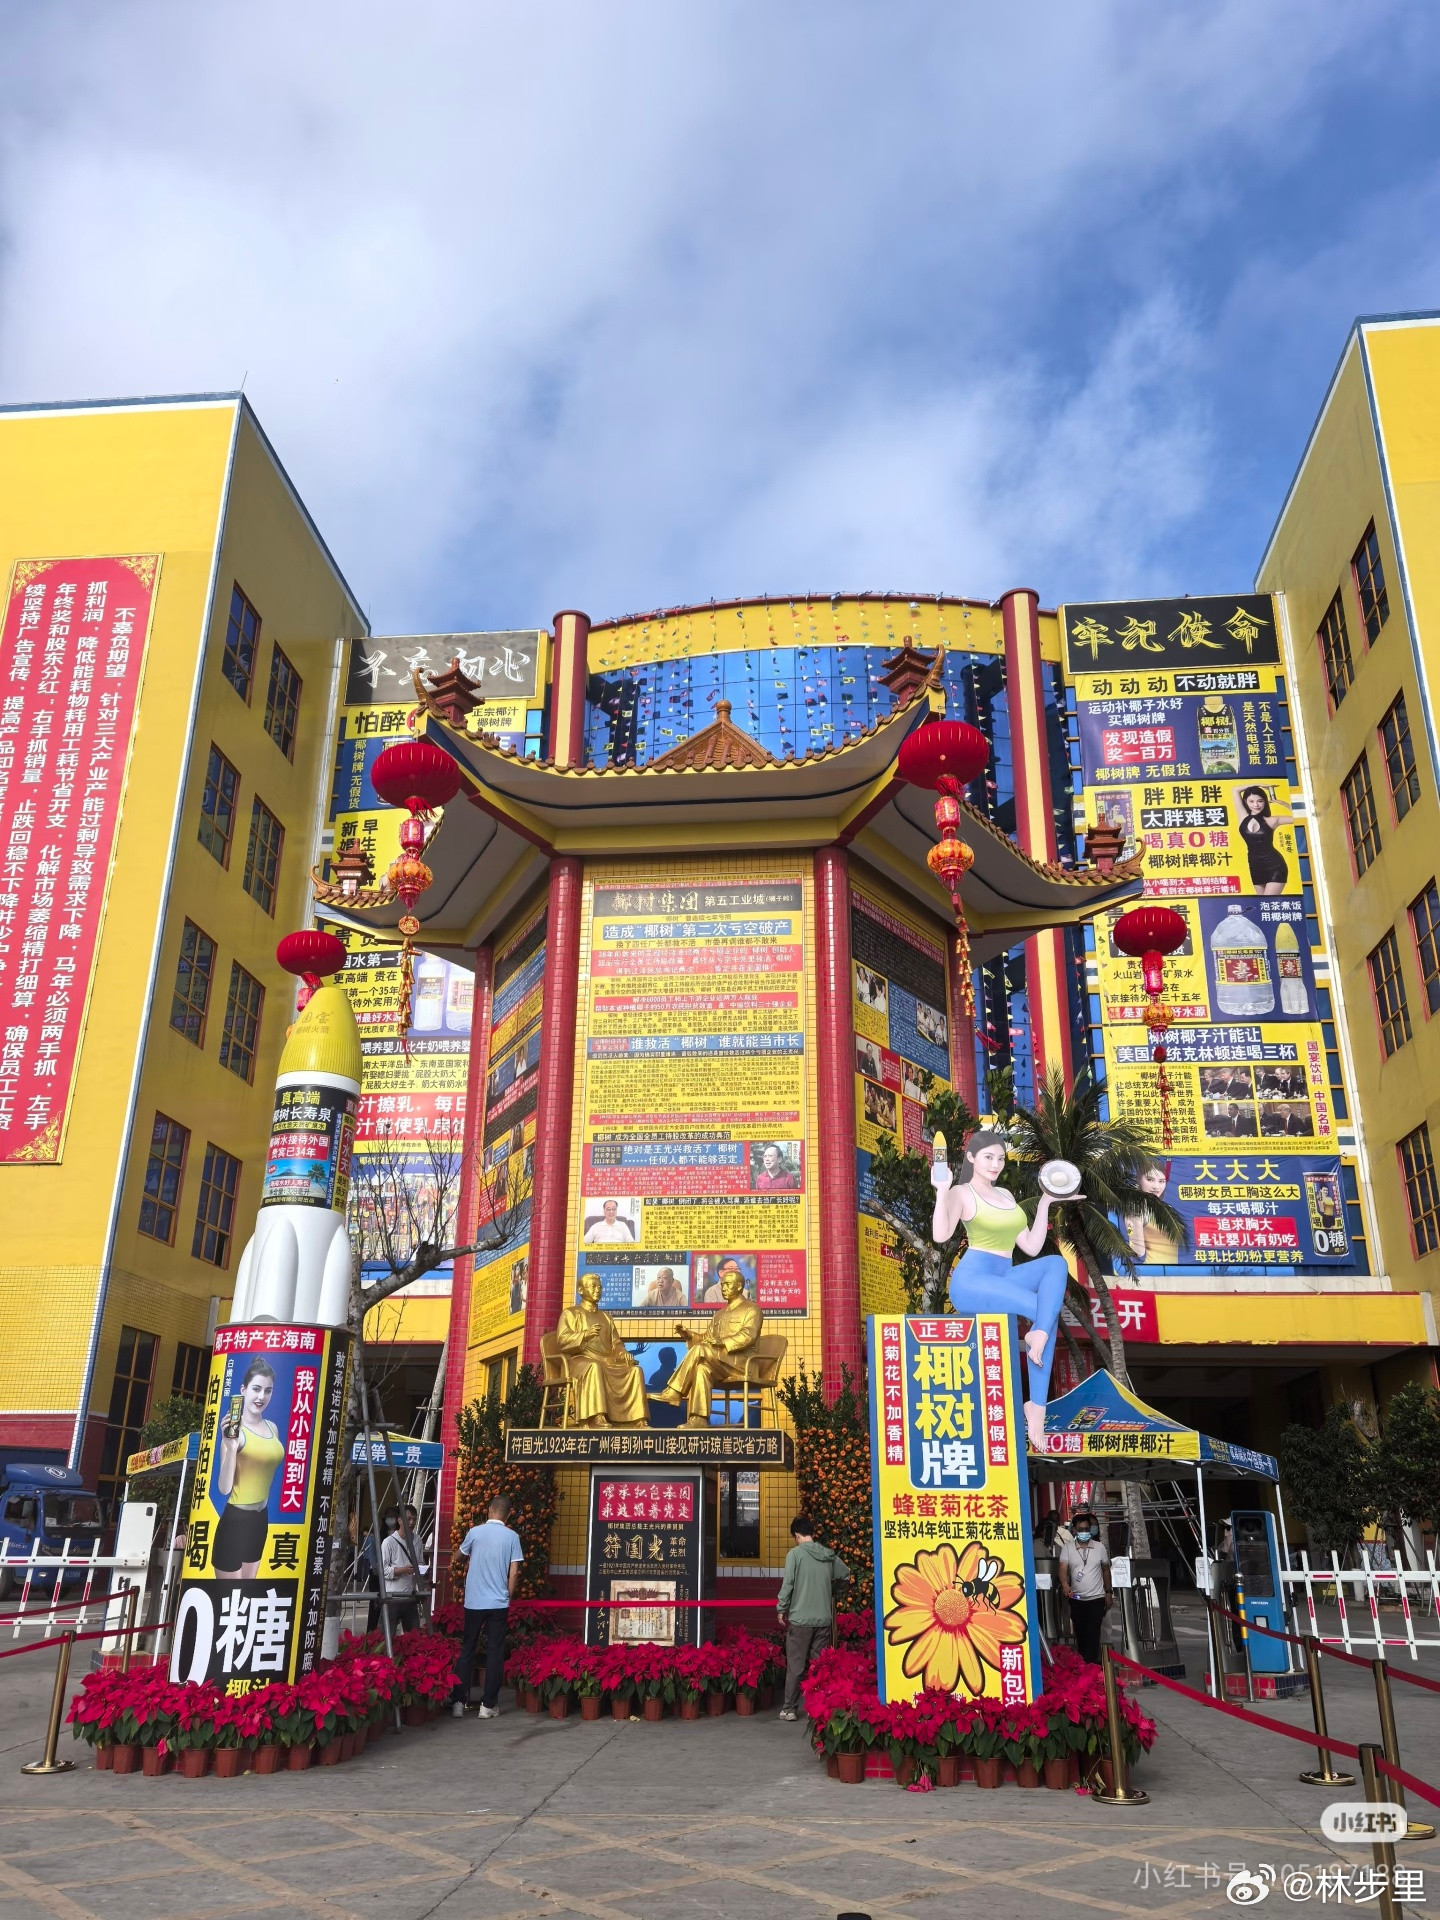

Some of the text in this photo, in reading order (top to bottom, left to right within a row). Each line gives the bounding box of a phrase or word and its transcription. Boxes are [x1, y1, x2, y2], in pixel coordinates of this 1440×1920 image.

[1072, 606, 1271, 661] 牢记使命
[1176, 672, 1257, 691] 不动就胖
[472, 705, 519, 718] 正宗椰汁
[1088, 698, 1183, 714] 运动补椰子水好
[477, 718, 512, 728] 椰树牌
[1109, 712, 1166, 726] 买椰树牌
[1106, 729, 1172, 746] 发现造假
[1243, 702, 1261, 765] 是天然电解质
[1259, 702, 1277, 765] 不是人工添加
[1107, 745, 1173, 762] 奖一百万
[1095, 763, 1191, 781] 椰树牌 无假货
[1143, 808, 1225, 828] 太胖难受
[1148, 852, 1233, 869] 椰树牌椰汁
[1260, 901, 1302, 910] 泡茶煮饭
[1261, 912, 1303, 921] 用椰树牌
[1119, 1044, 1296, 1063] 美国统克林顿连喝三杯
[1307, 1041, 1323, 1085] 国宴饮料
[281, 1091, 320, 1106] 真高端
[1314, 1092, 1331, 1137] 中国名牌
[1180, 1186, 1299, 1199] 椰树女员工胸这么大
[1207, 1202, 1278, 1215] 每天喝椰汁
[1217, 1217, 1273, 1231] 追求胸大
[1198, 1233, 1297, 1247] 是让婴儿有奶吃
[1194, 1249, 1303, 1263] 母乳比奶粉更营养
[919, 1321, 964, 1338] 正宗
[215, 1330, 316, 1351] 椰子特产在海南
[884, 1326, 903, 1462] 纯菊花不加香精
[983, 1326, 1007, 1463] 真蜂蜜不掺假蜜
[913, 1346, 978, 1486] 椰树牌
[282, 1370, 315, 1509] 我从小喝到大
[1088, 1433, 1175, 1453] 椰树牌椰汁
[893, 1493, 1009, 1519] 蜂蜜菊花茶
[312, 1495, 331, 1575] 不加色素
[884, 1519, 1020, 1541] 坚持34年纯正菊花煮出
[186, 1521, 300, 1571] 喝 真
[170, 1588, 292, 1687] 0糖
